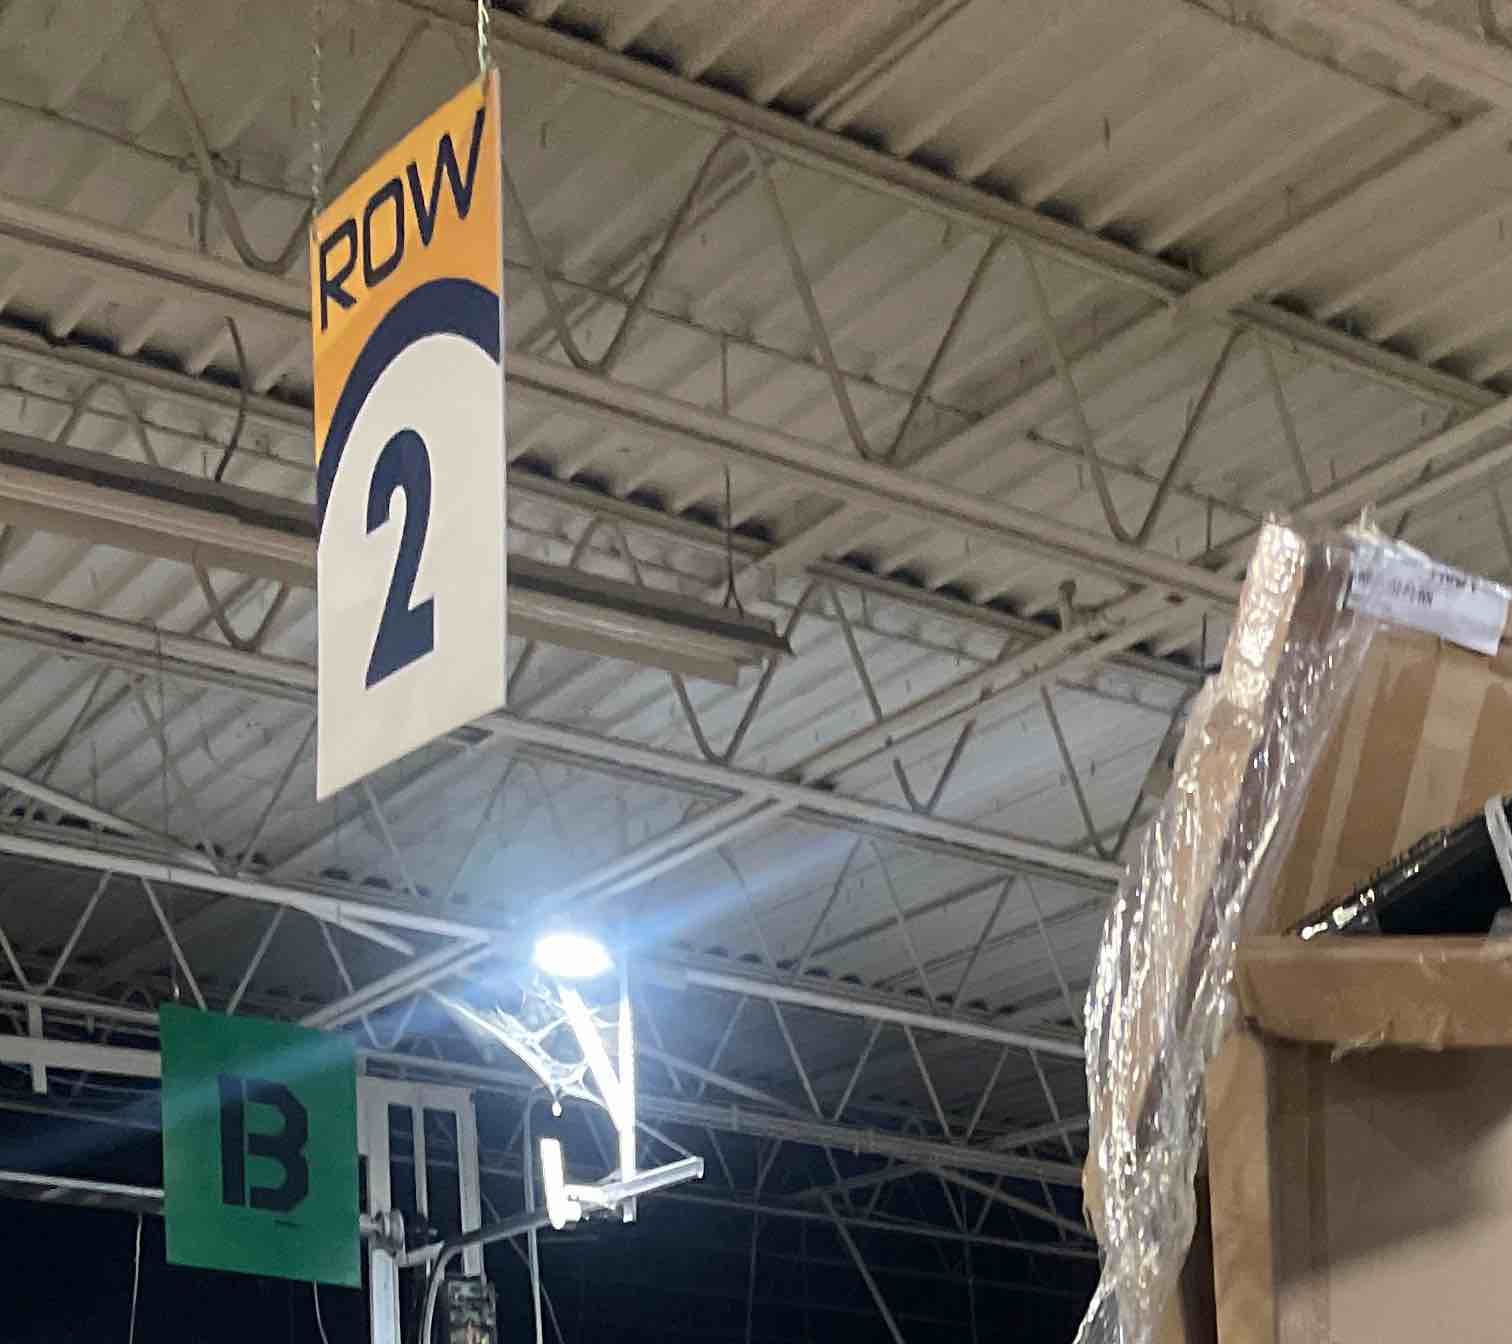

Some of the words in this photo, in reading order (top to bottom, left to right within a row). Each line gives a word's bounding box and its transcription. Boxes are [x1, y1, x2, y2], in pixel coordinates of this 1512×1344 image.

[319, 107, 486, 330] ROW
[365, 428, 435, 690] 2
[219, 1074, 309, 1214] B
